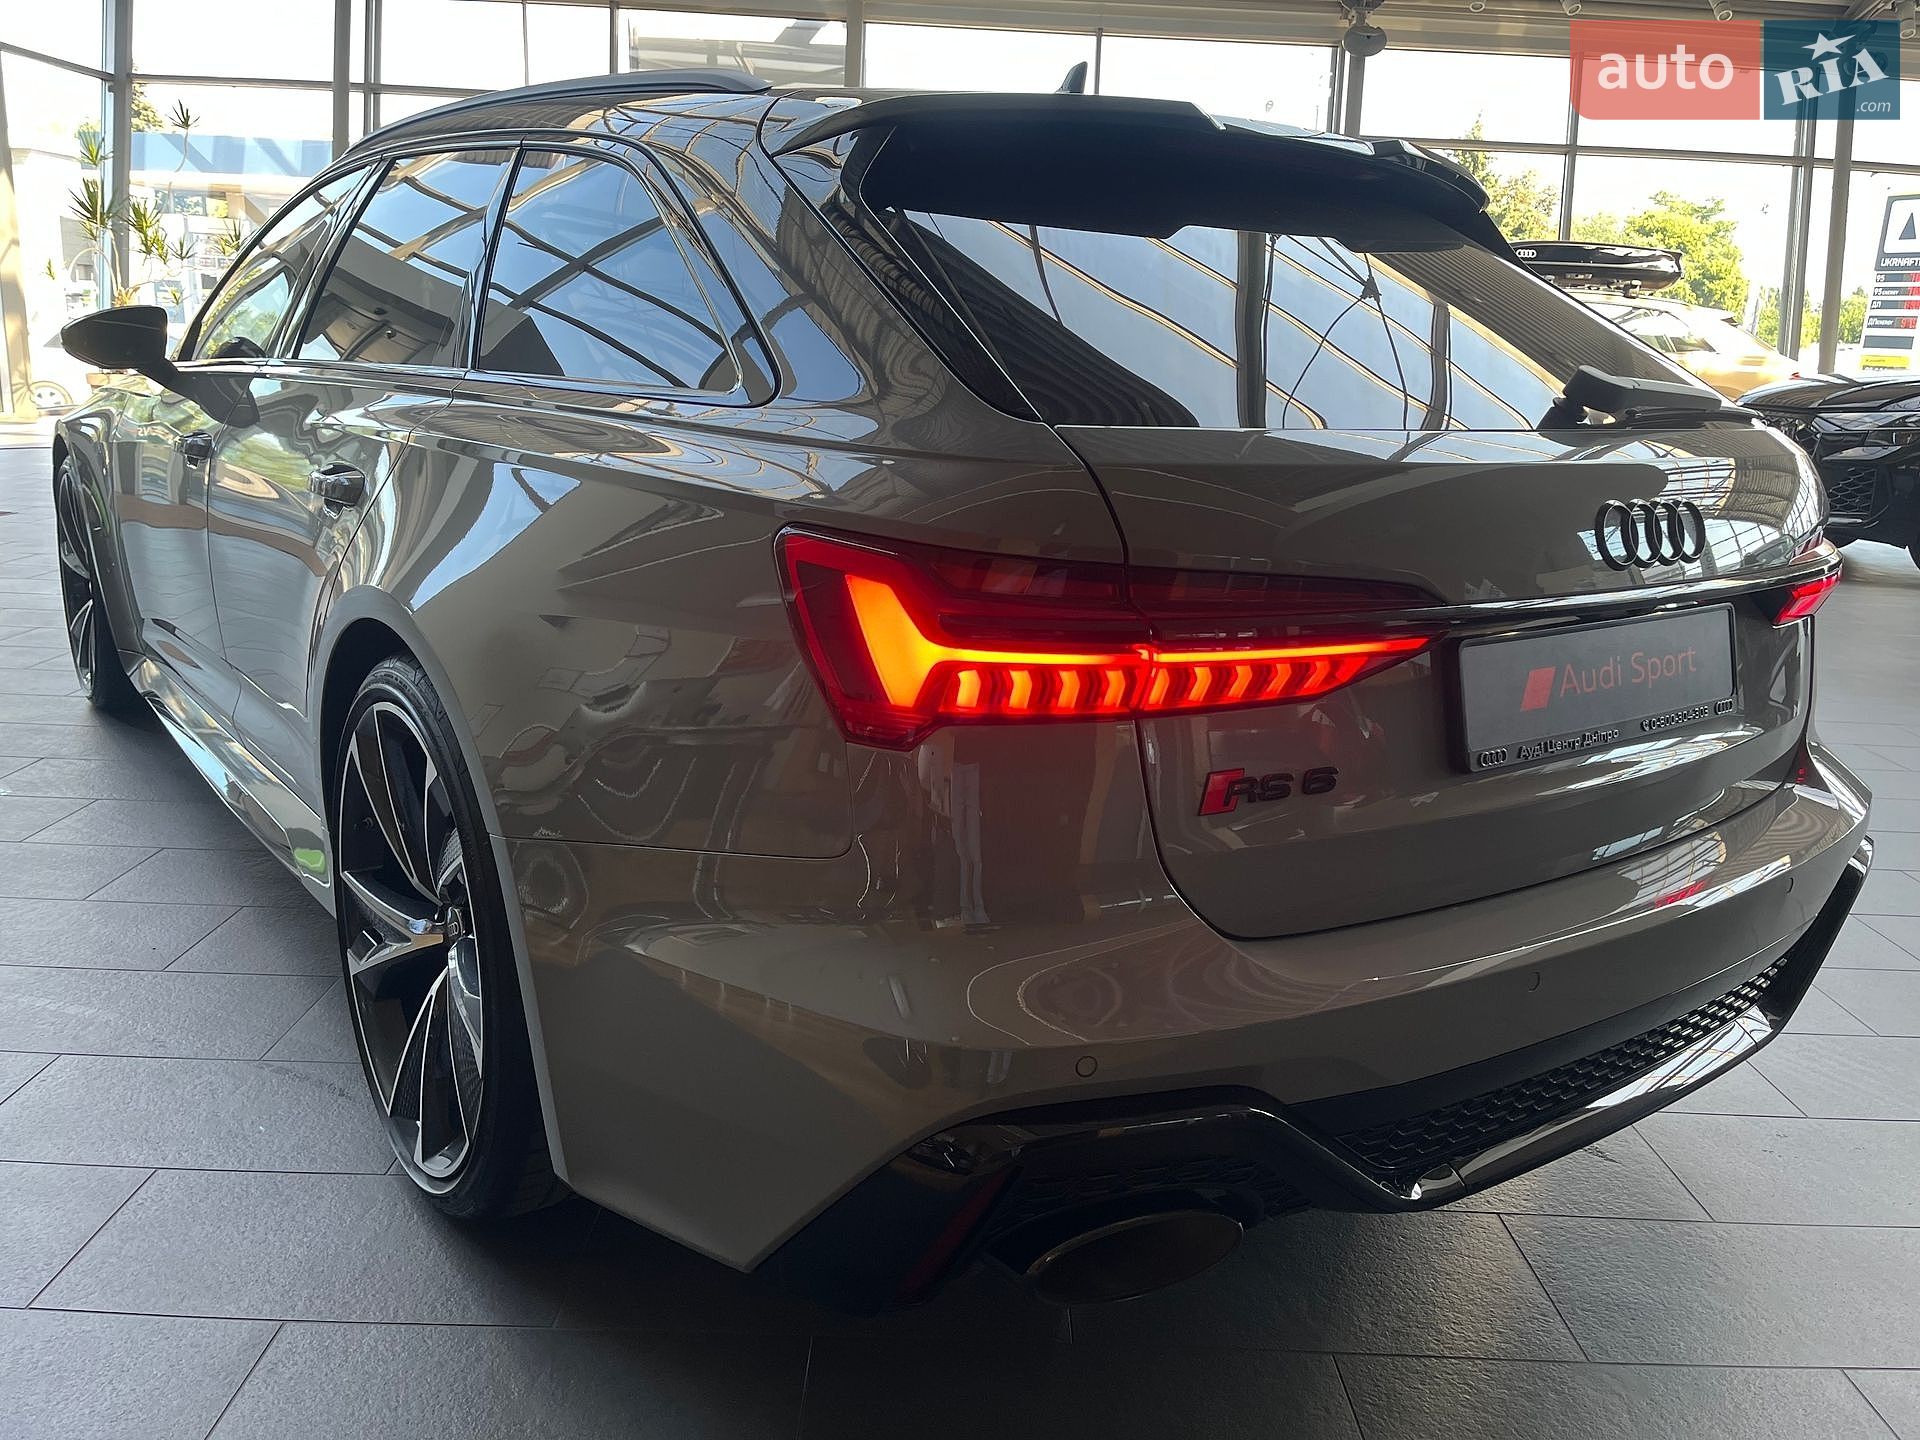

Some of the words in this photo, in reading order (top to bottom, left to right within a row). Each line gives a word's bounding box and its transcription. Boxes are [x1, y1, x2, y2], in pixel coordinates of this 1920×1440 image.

[1880, 257, 1920, 267] UKRNAFT
[1560, 655, 1622, 697] Audi
[1631, 647, 1697, 688] Sport
[1547, 737, 1581, 753] Центр
[1583, 729, 1620, 747] Дніпро
[1223, 771, 1295, 807] RS
[1302, 766, 1340, 795] 6
